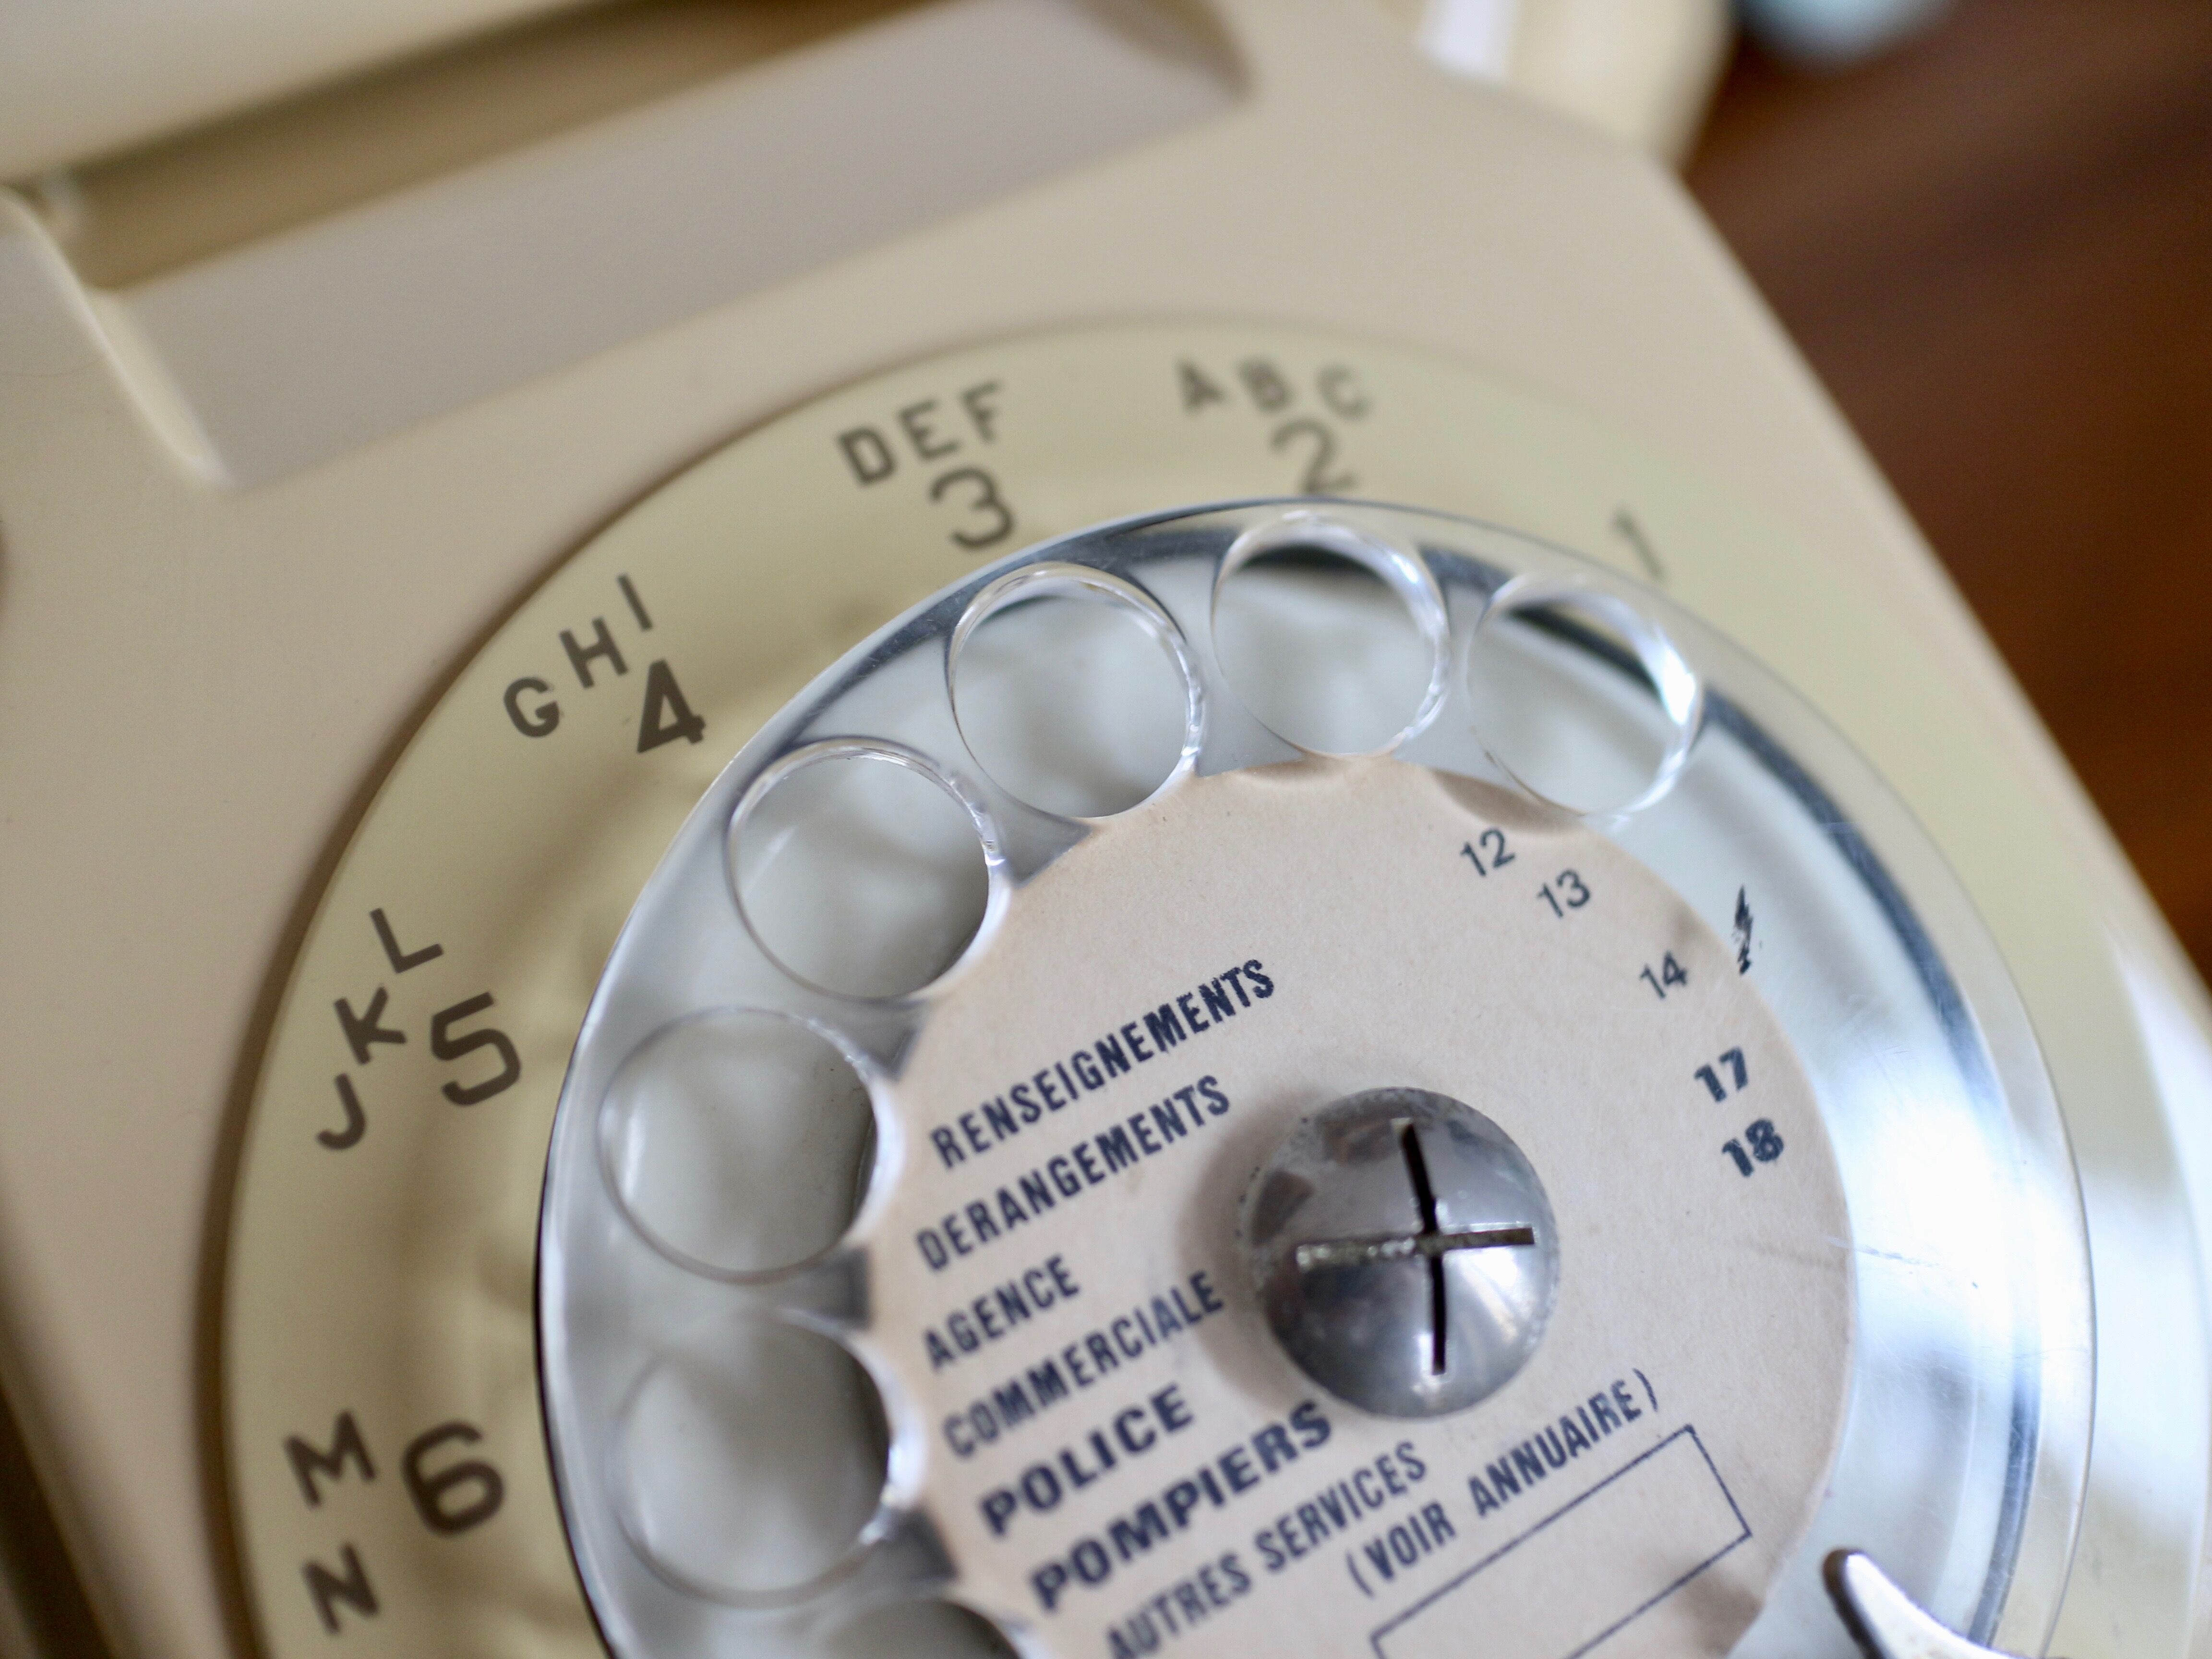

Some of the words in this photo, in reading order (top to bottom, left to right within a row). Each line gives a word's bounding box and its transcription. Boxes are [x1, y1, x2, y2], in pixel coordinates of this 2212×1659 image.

[835, 382, 1000, 488] DEF
[1270, 418, 1356, 495] 2
[928, 467, 1015, 549] 3
[1612, 505, 1668, 581] 1
[637, 658, 707, 754] 4
[1460, 828, 1515, 877] 12
[1538, 870, 1591, 918] 13
[1640, 950, 1688, 999] 14
[431, 991, 522, 1106] 5
[931, 959, 1274, 1170] RENSEIGNEMENTS
[1694, 1046, 1748, 1103] 17
[915, 1075, 1230, 1271] DERANGEMENTS
[1721, 1118, 1784, 1177] 18
[923, 1254, 1081, 1370] AGENCE
[943, 1271, 1224, 1459] COMMERCIALE
[401, 1420, 505, 1537] 6
[979, 1383, 1194, 1537] POLICE
[1030, 1399, 1332, 1611] POMPIERS
[1345, 1501, 1456, 1597] (VOIR
[1467, 1368, 1658, 1516] ANNUAIRE)
[1106, 1552, 1251, 1659] AUTRES
[1254, 1441, 1427, 1572] SERVICES
